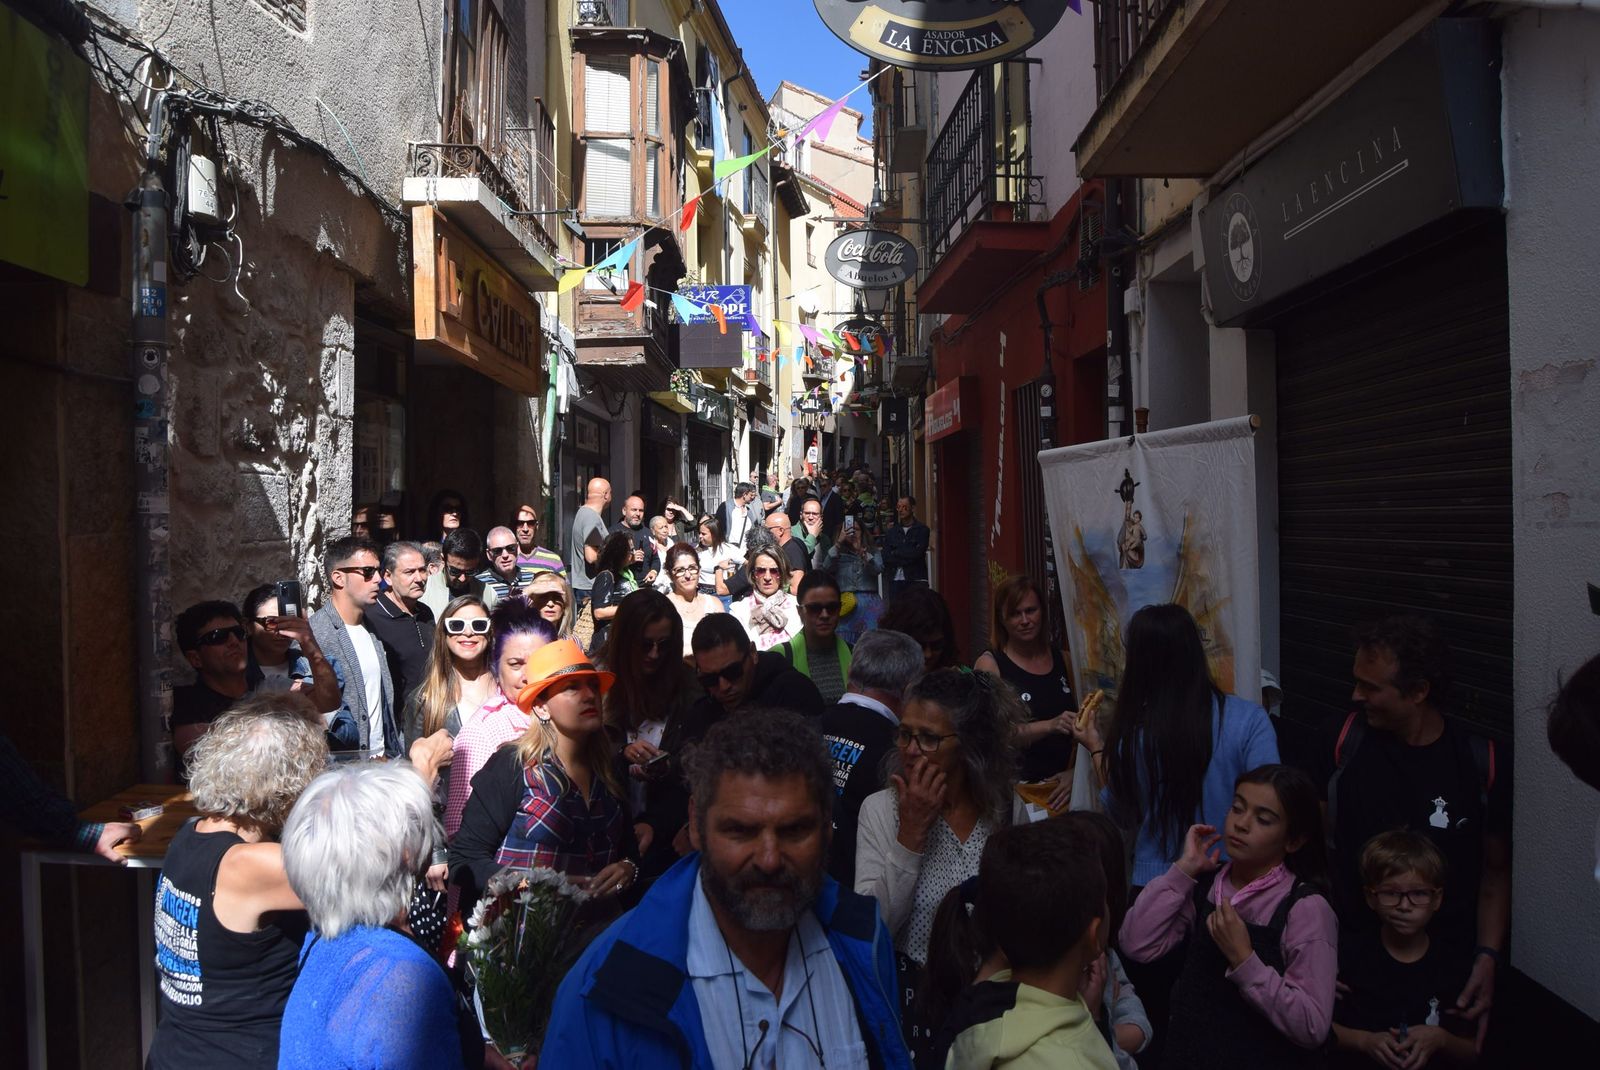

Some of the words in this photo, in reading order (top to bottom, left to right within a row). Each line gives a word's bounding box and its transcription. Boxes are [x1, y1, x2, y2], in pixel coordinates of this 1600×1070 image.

[924, 30, 966, 39] ASADOR
[885, 29, 913, 51] LA
[920, 31, 1004, 56] ENCINA
[846, 271, 889, 282] Abuelos
